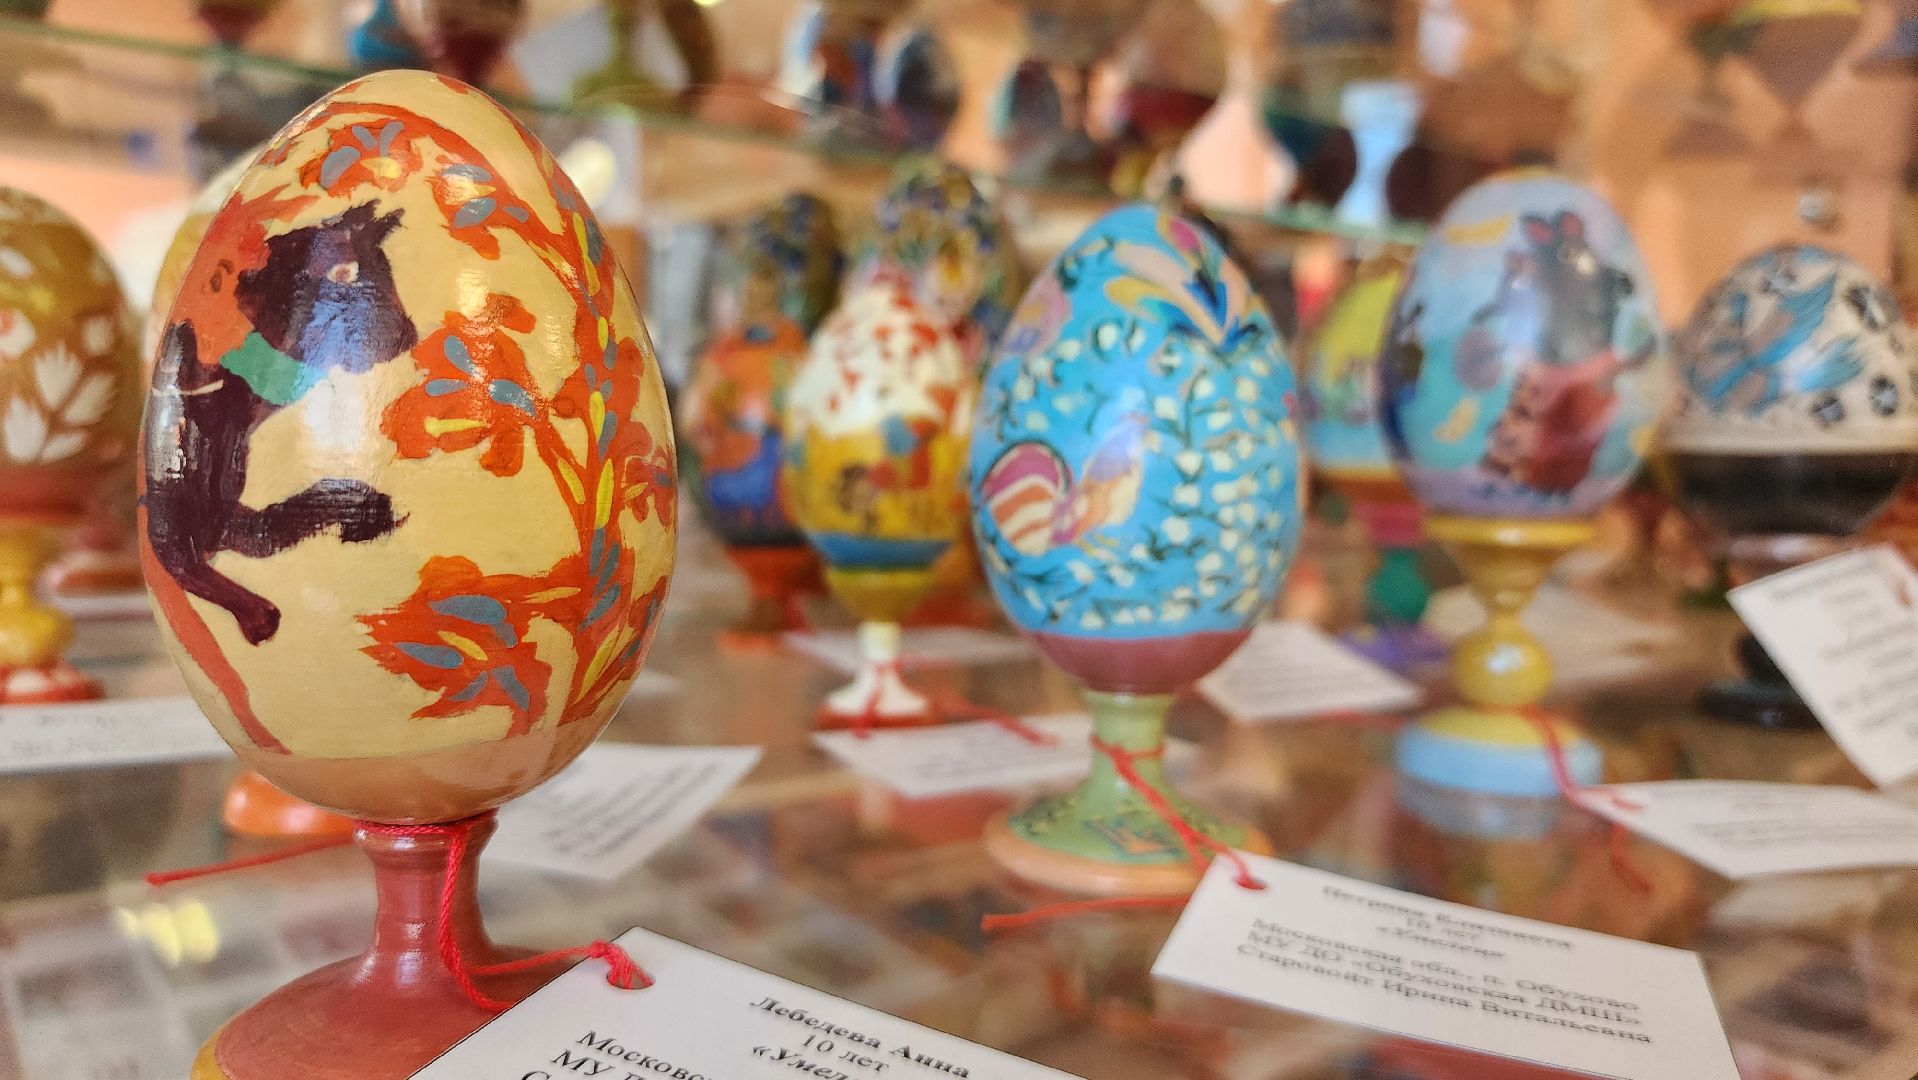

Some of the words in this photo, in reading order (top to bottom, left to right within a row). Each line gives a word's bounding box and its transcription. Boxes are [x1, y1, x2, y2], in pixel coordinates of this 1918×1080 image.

[1238, 943, 1374, 986] Старовойт
[1382, 979, 1472, 1008] Ирина
[1481, 1000, 1652, 1043] Витальевна
[1248, 930, 1294, 948] МУ
[1299, 945, 1342, 961] ДО
[1351, 960, 1526, 1003] «Обуховская
[1253, 918, 1402, 963] Московская
[1515, 979, 1640, 1010] Обухово
[551, 1048, 615, 1076] МУ
[750, 997, 881, 1049] Лебедева
[888, 1045, 970, 1078] Анна
[802, 1034, 835, 1052] 10
[838, 1050, 889, 1073] лет
